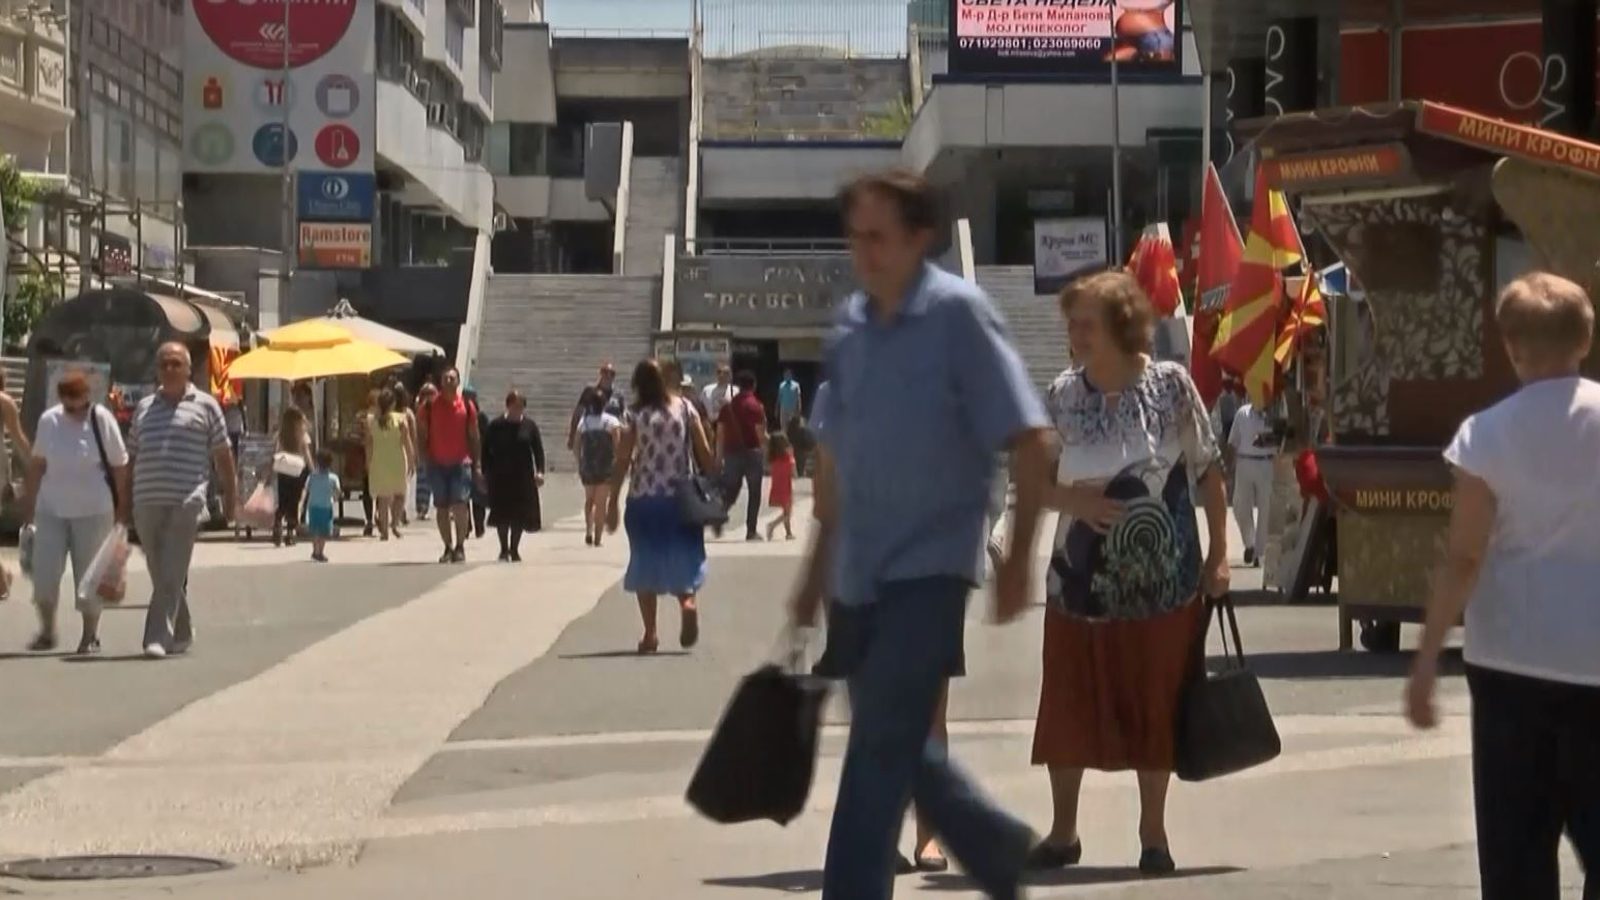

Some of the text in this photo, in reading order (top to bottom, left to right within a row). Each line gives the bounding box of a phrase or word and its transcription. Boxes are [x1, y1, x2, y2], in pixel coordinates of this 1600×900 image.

[961, 10, 1111, 21] М-р Д-р Бети Миланова
[1015, 24, 1087, 33] ГИНЕКОЛОГ
[1458, 116, 1522, 147] МИНИ
[1280, 154, 1379, 179] МИНИ КРОФНИ
[302, 226, 370, 241] Ramstore
[1356, 490, 1402, 508] МИНИ
